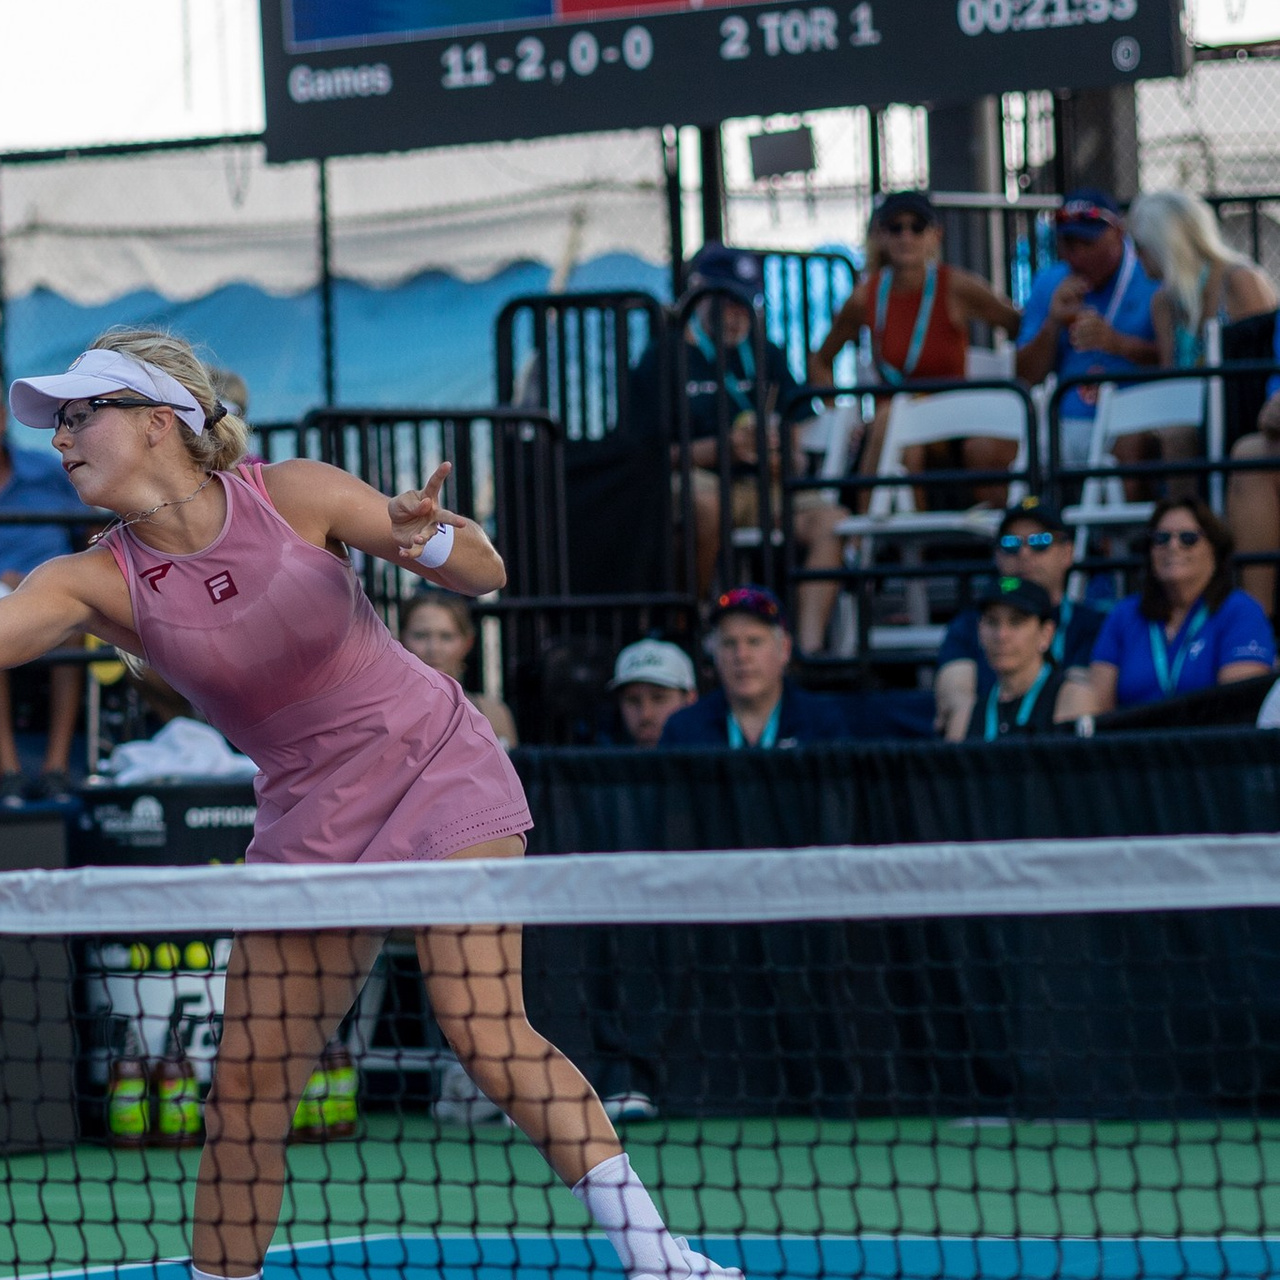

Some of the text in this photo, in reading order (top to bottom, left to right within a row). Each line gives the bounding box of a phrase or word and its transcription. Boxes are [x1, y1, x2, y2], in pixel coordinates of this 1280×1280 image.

[721, 1, 882, 61] 2 TOR 1
[288, 63, 393, 103] Games
